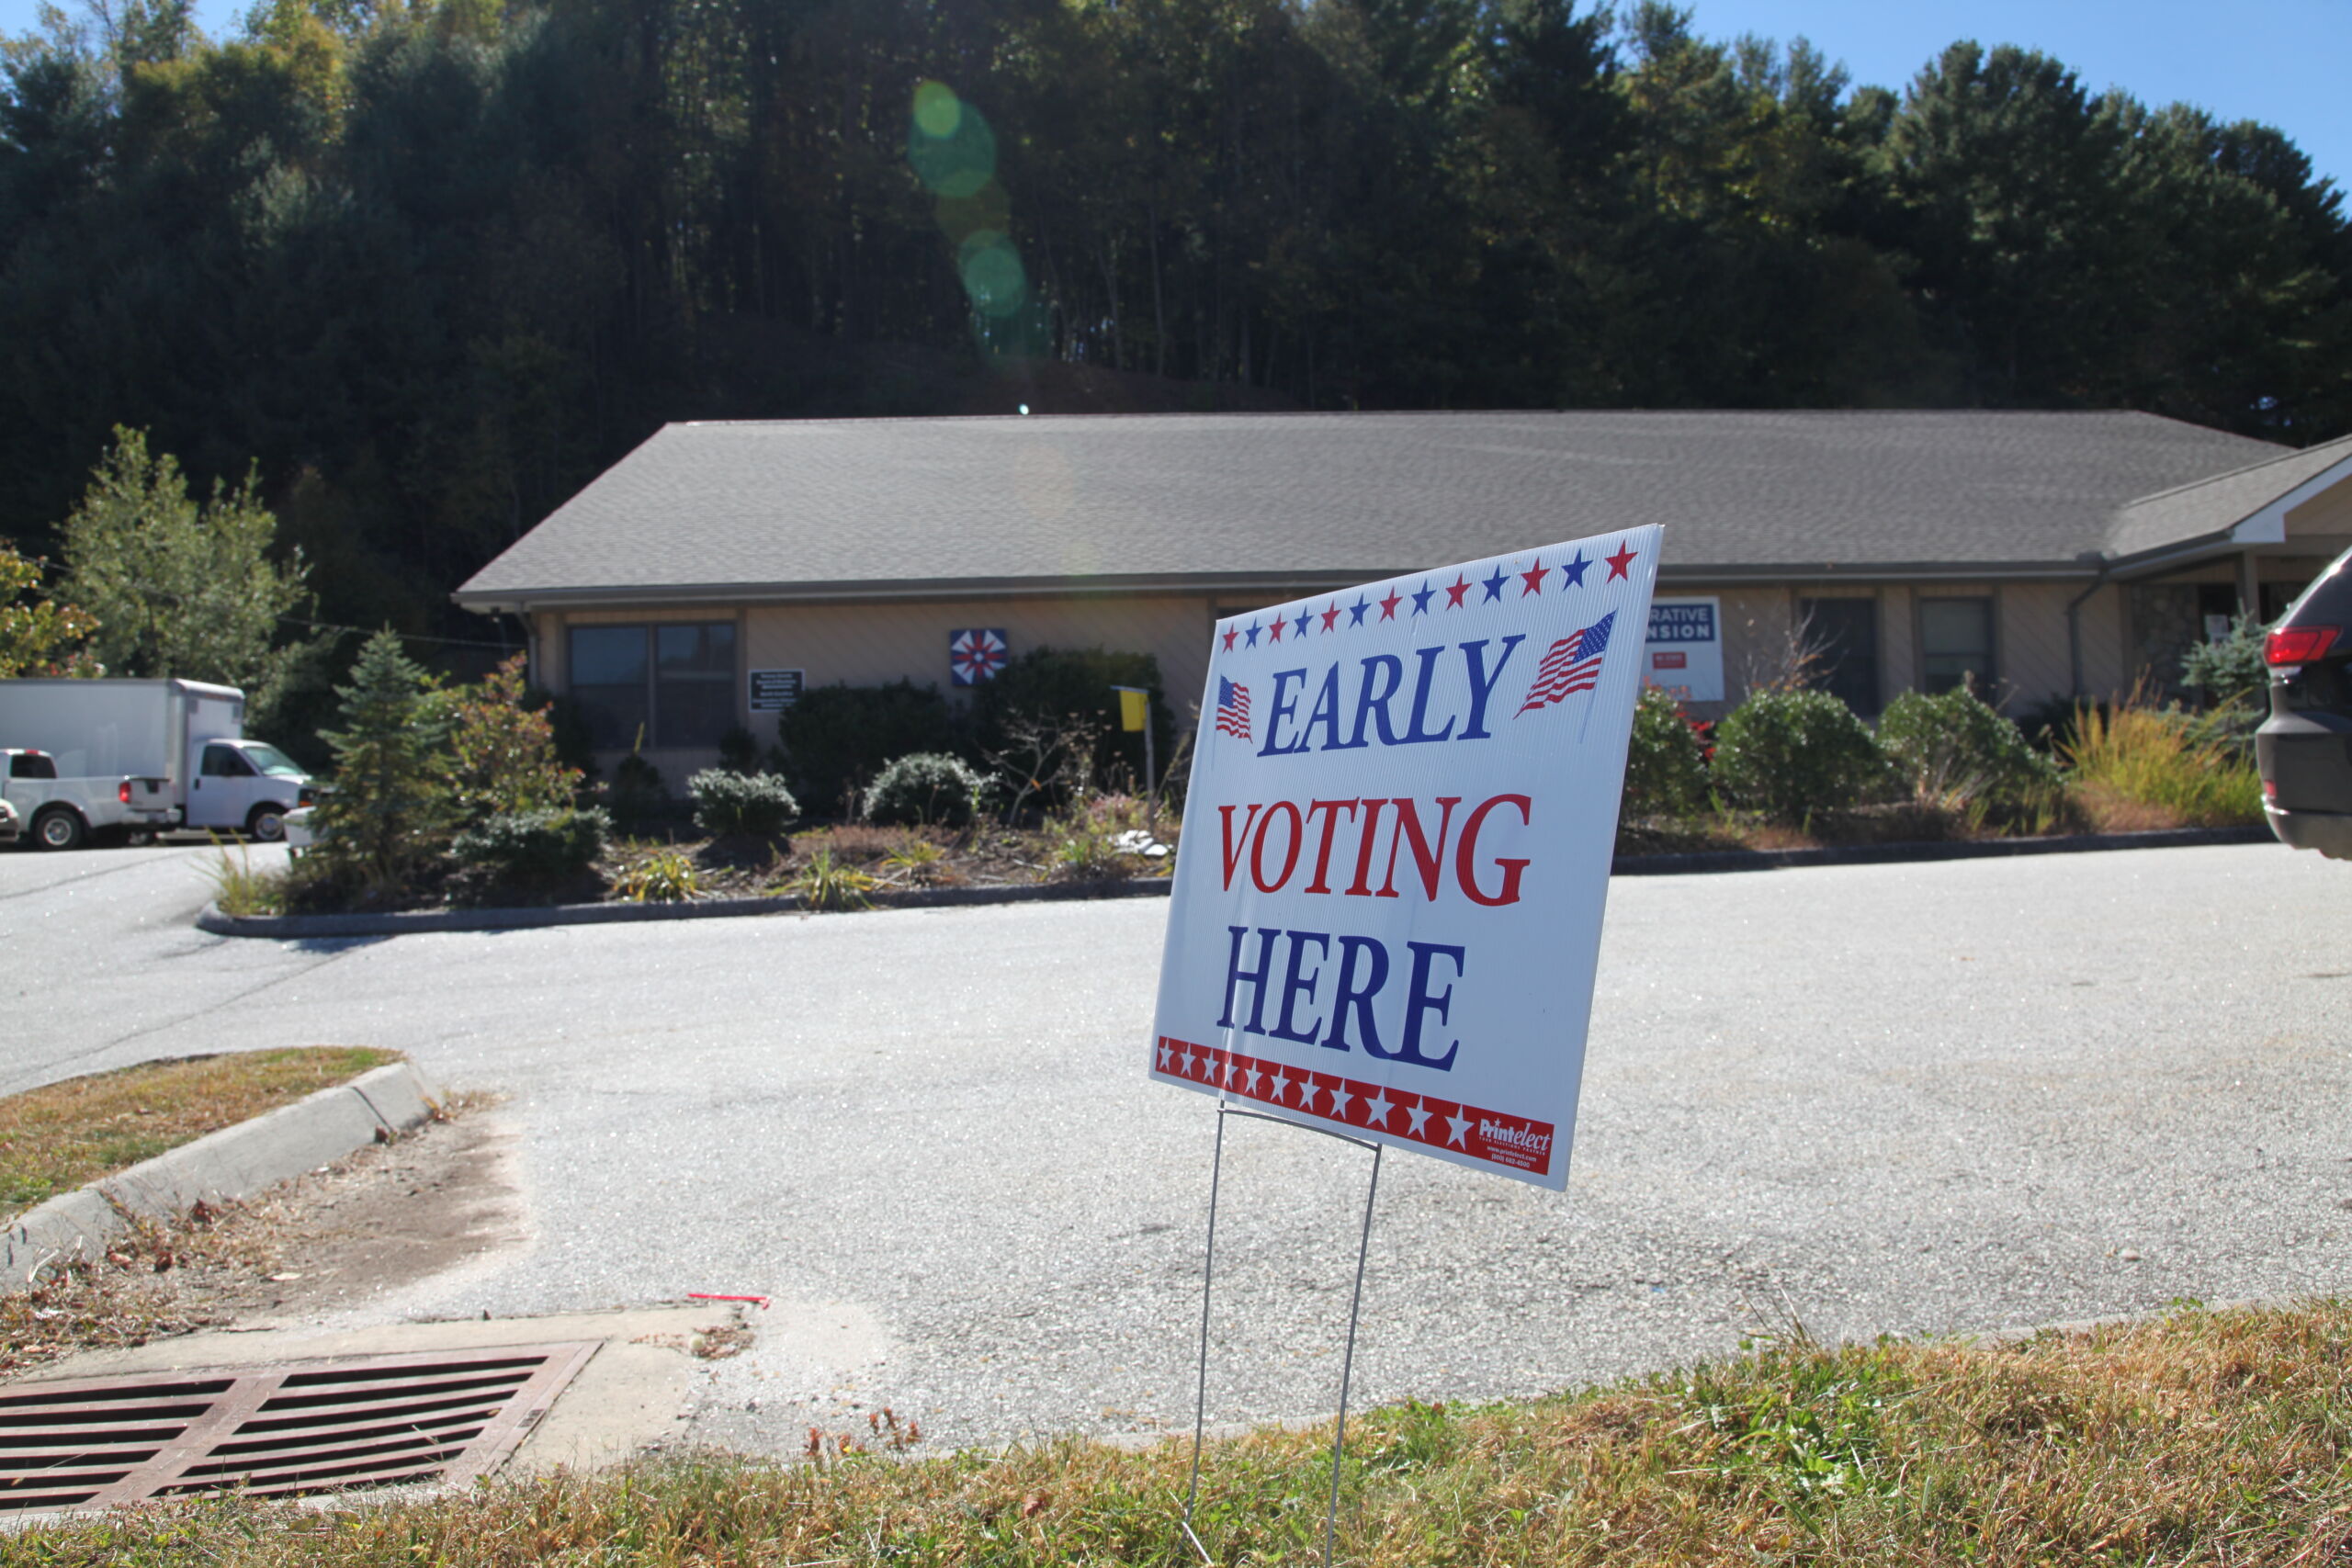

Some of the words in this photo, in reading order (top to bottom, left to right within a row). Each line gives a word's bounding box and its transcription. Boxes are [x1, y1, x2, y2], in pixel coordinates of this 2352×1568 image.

[1257, 634, 1526, 757] EARLY
[1217, 794, 1532, 907] VOTING
[1216, 925, 1465, 1072] HERE
[1479, 1118, 1551, 1151] Printelect
